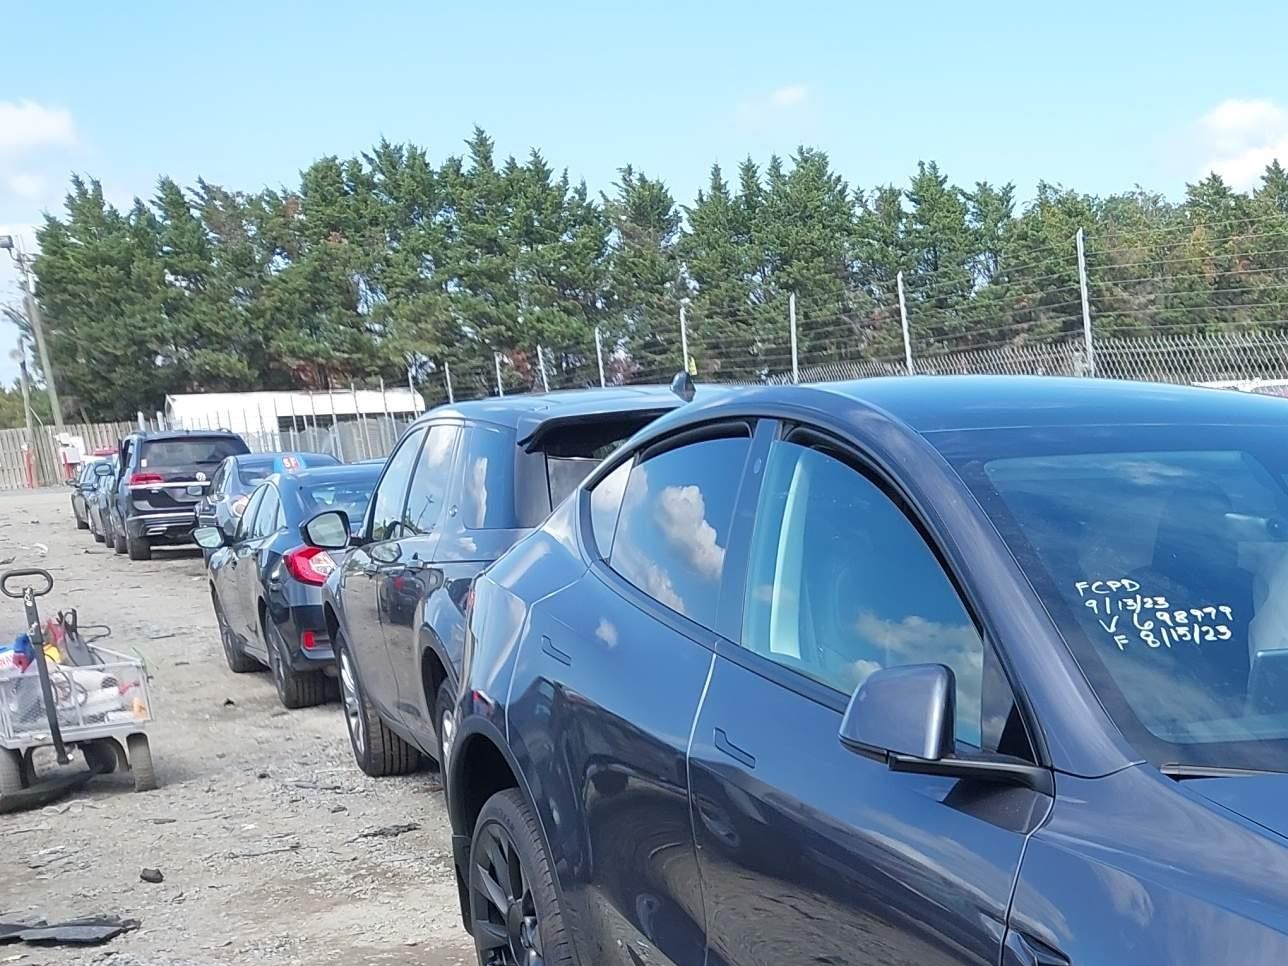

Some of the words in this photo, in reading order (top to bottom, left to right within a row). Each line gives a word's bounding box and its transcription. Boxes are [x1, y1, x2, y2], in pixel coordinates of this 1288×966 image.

[1075, 578, 1141, 597] FCPD
[1113, 634, 1129, 651] F
[1139, 623, 1233, 649] 8/15/23
